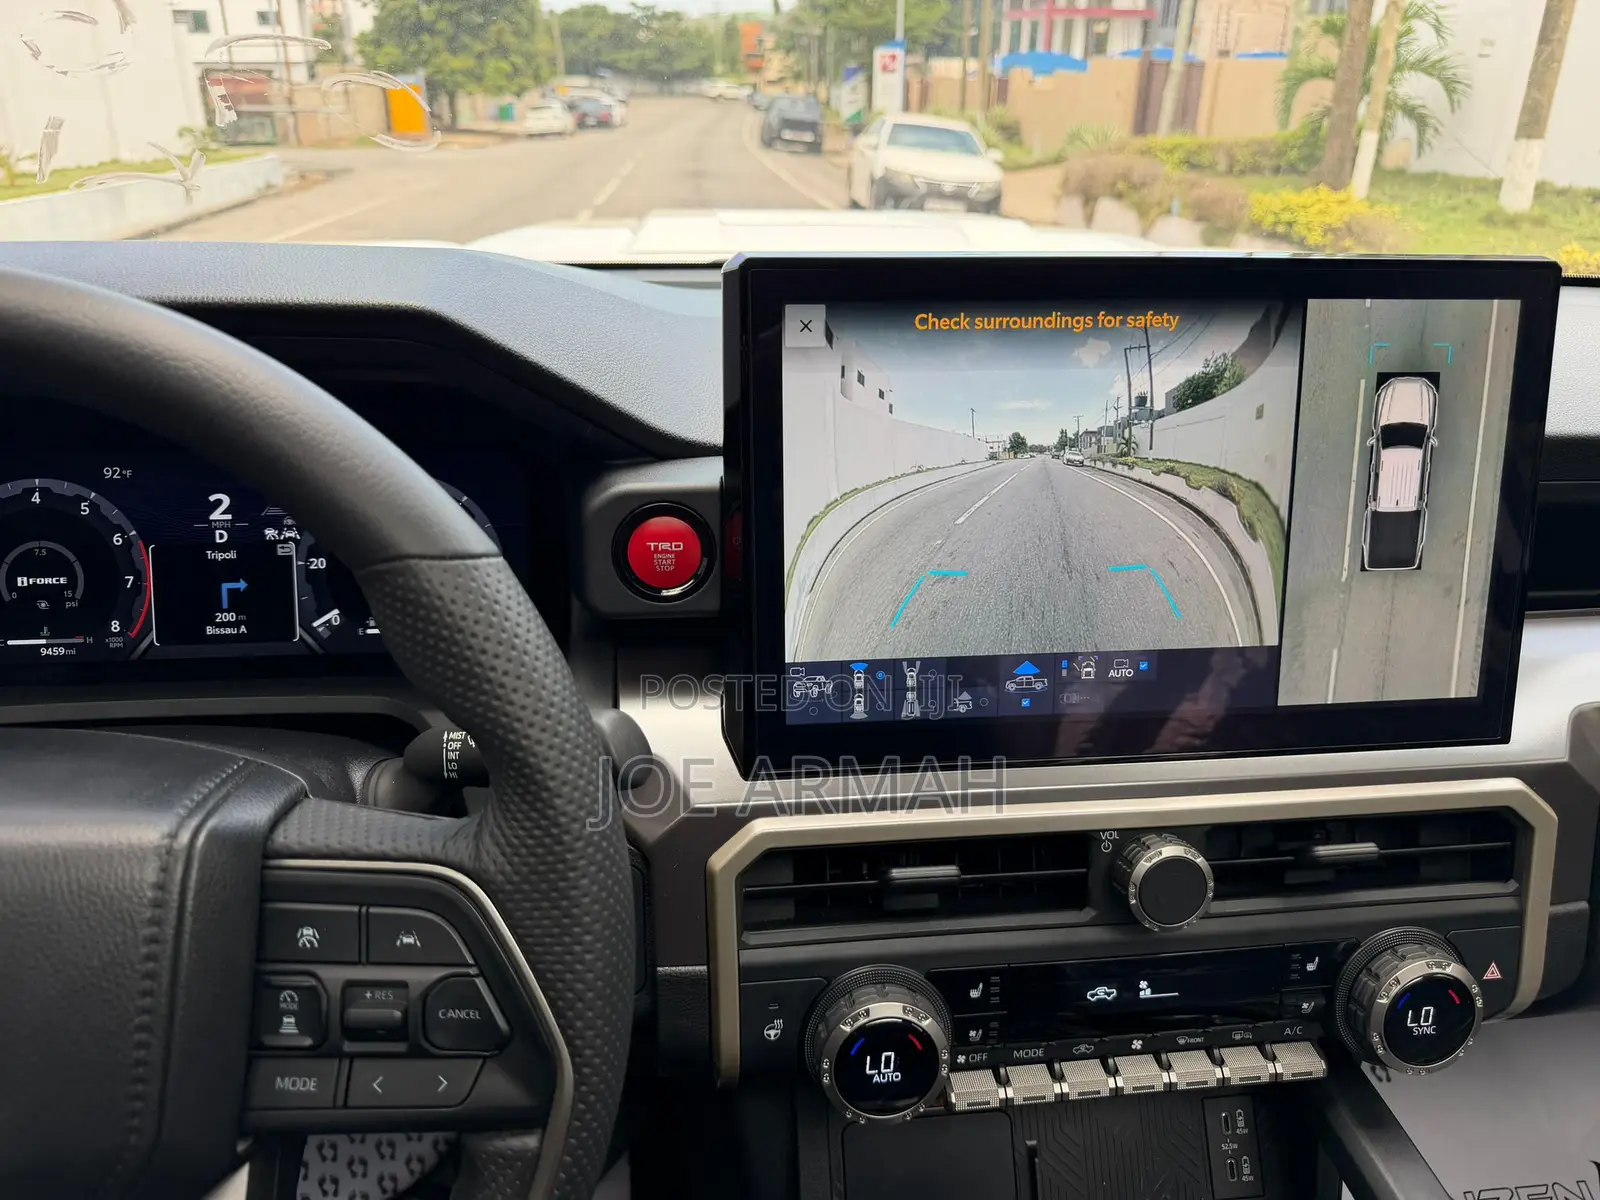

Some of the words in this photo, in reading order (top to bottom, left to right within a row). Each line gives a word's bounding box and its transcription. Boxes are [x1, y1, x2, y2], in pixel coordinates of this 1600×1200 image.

[914, 313, 970, 330] Check
[974, 312, 1094, 333] surroundings
[1097, 311, 1122, 328] for
[1126, 310, 1180, 332] safety
[31, 492, 41, 504] 4
[80, 502, 90, 515] 5
[208, 493, 232, 520] 2
[112, 533, 123, 546] 6
[215, 530, 228, 543] D
[646, 542, 683, 551] TRD
[206, 551, 237, 561] Tripoli
[124, 576, 134, 588] 7
[63, 590, 73, 598] 15
[65, 600, 78, 609] psi
[215, 612, 236, 622] 200
[331, 614, 340, 626] 0
[111, 620, 120, 633] 8
[206, 626, 237, 635] Bissau
[239, 625, 247, 634] A
[1108, 668, 1134, 678] AUTO
[448, 731, 466, 740] MIST
[447, 741, 462, 750] OFF
[447, 751, 460, 760] INT
[447, 762, 458, 770] LO
[1100, 830, 1119, 840] VOL
[439, 1008, 481, 1019] CANCEL
[1283, 1025, 1303, 1036] A/C
[1412, 1025, 1437, 1036] SYNC
[1187, 1036, 1205, 1044] FRONT
[968, 1052, 989, 1063] OFF
[1013, 1047, 1045, 1060] MODE
[872, 1071, 902, 1084] AUTO
[275, 1075, 318, 1091] MODE
[1235, 1127, 1249, 1135] 45W
[1221, 1142, 1239, 1151] 52.5W
[1241, 1174, 1254, 1182] 45W
